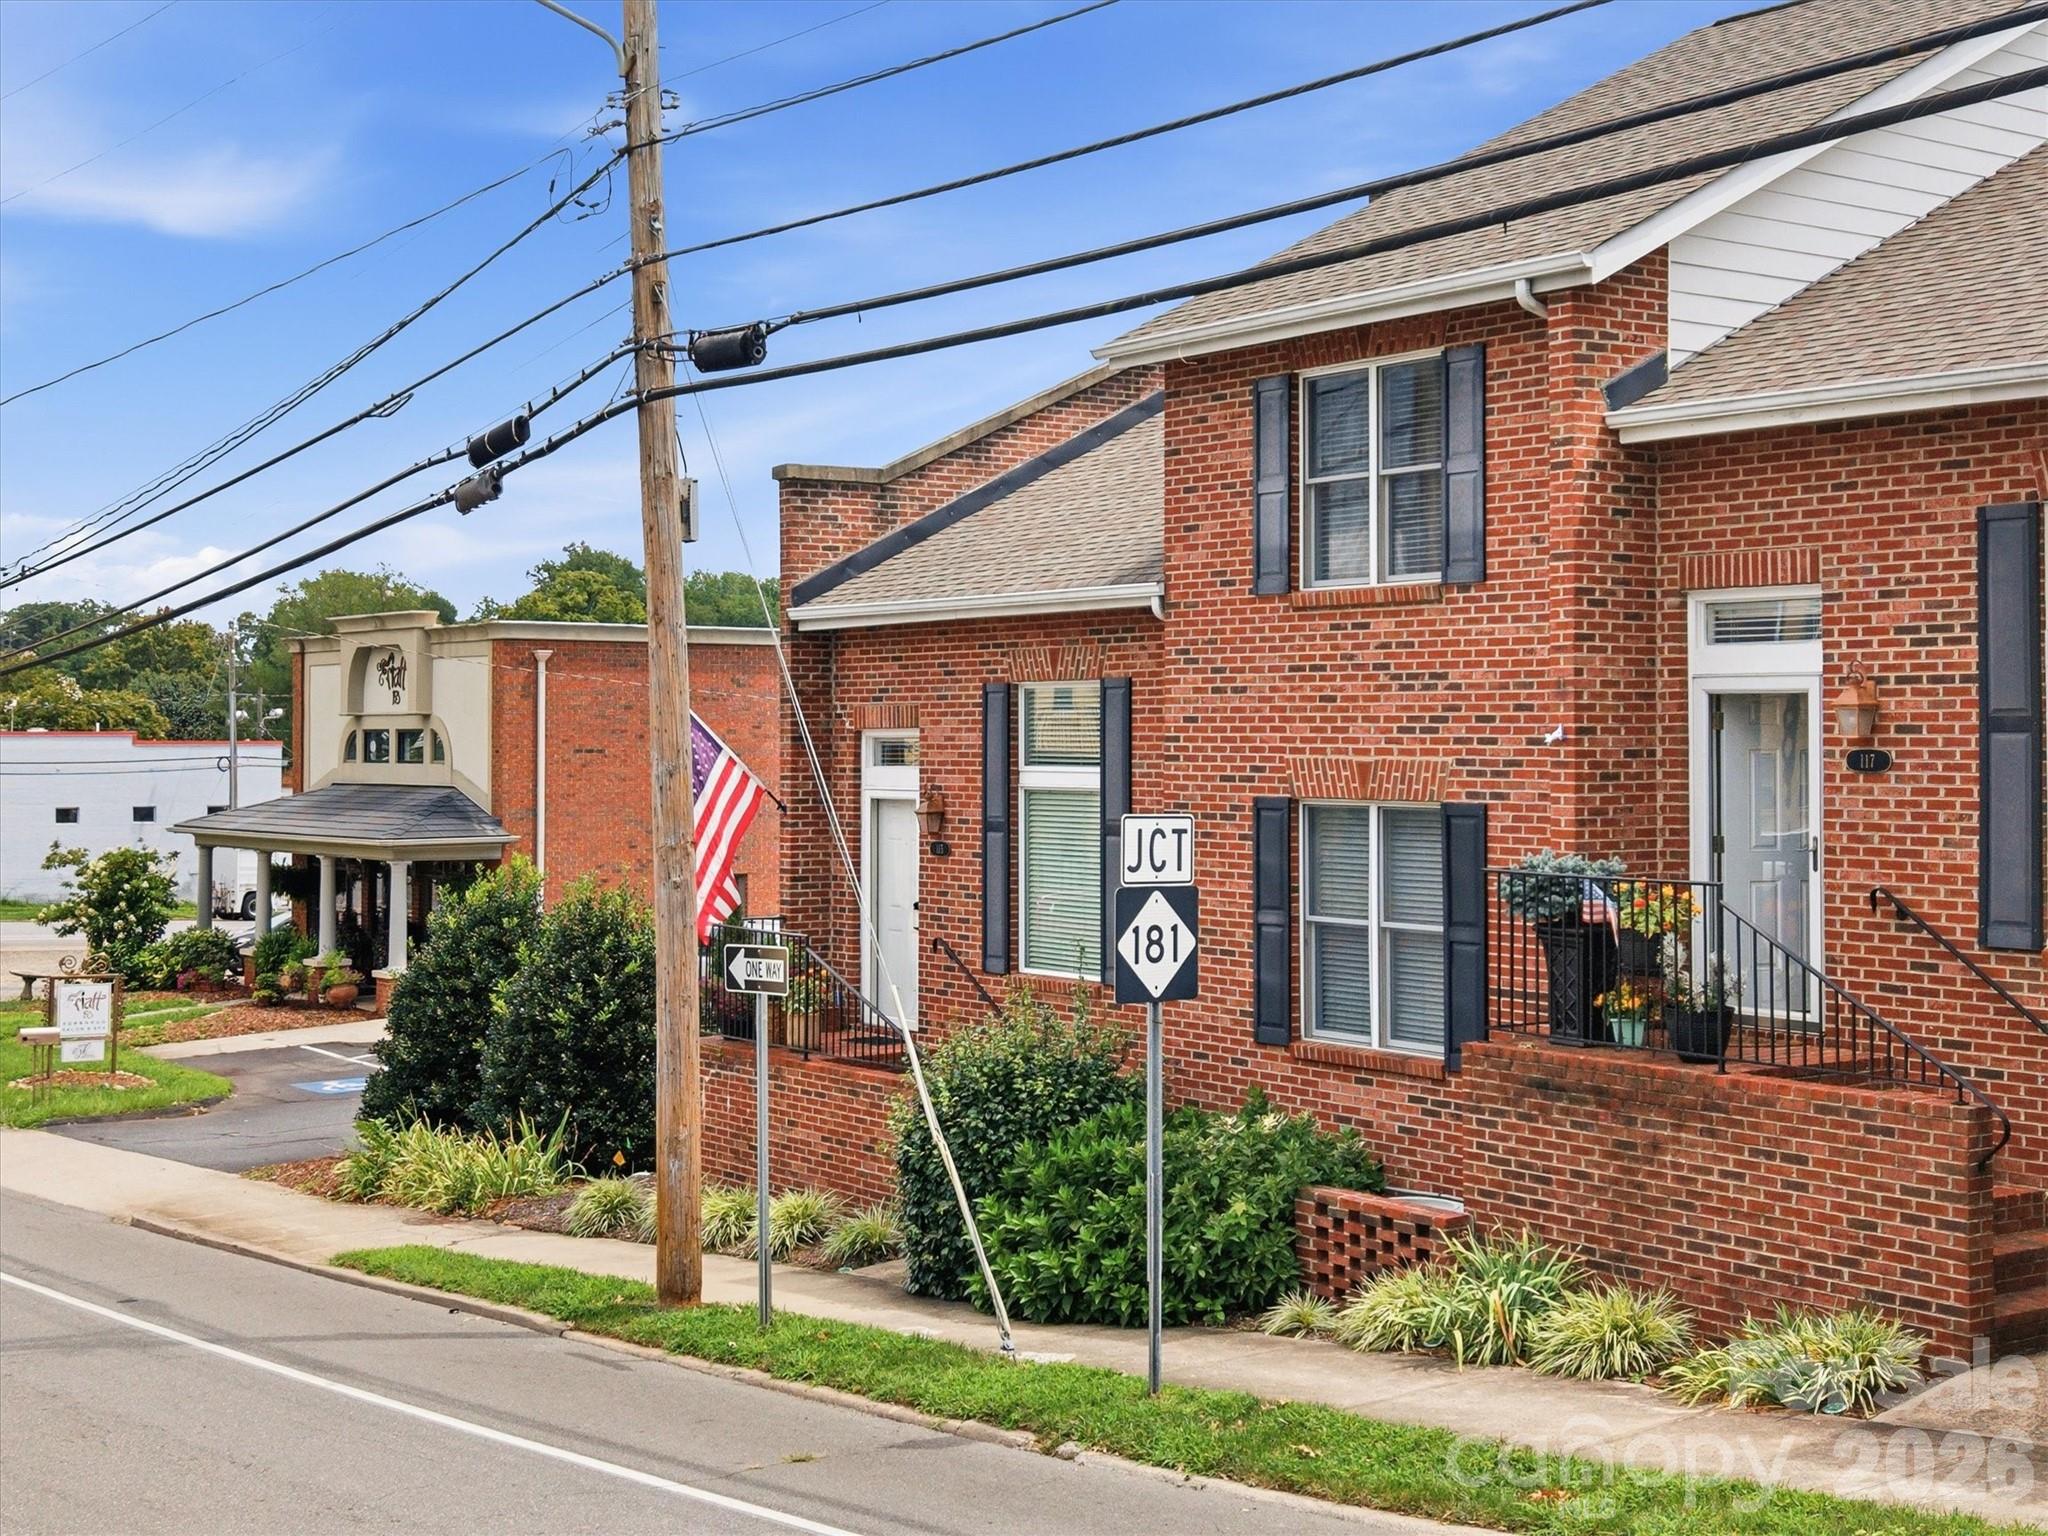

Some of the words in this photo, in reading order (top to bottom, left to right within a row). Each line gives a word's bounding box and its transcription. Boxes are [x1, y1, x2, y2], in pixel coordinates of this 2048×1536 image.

[1860, 753, 1875, 769] 117
[1127, 828, 1188, 873] JCT
[1132, 923, 1178, 965] 181
[745, 960, 763, 978] ONE
[765, 961, 782, 979] WAY
